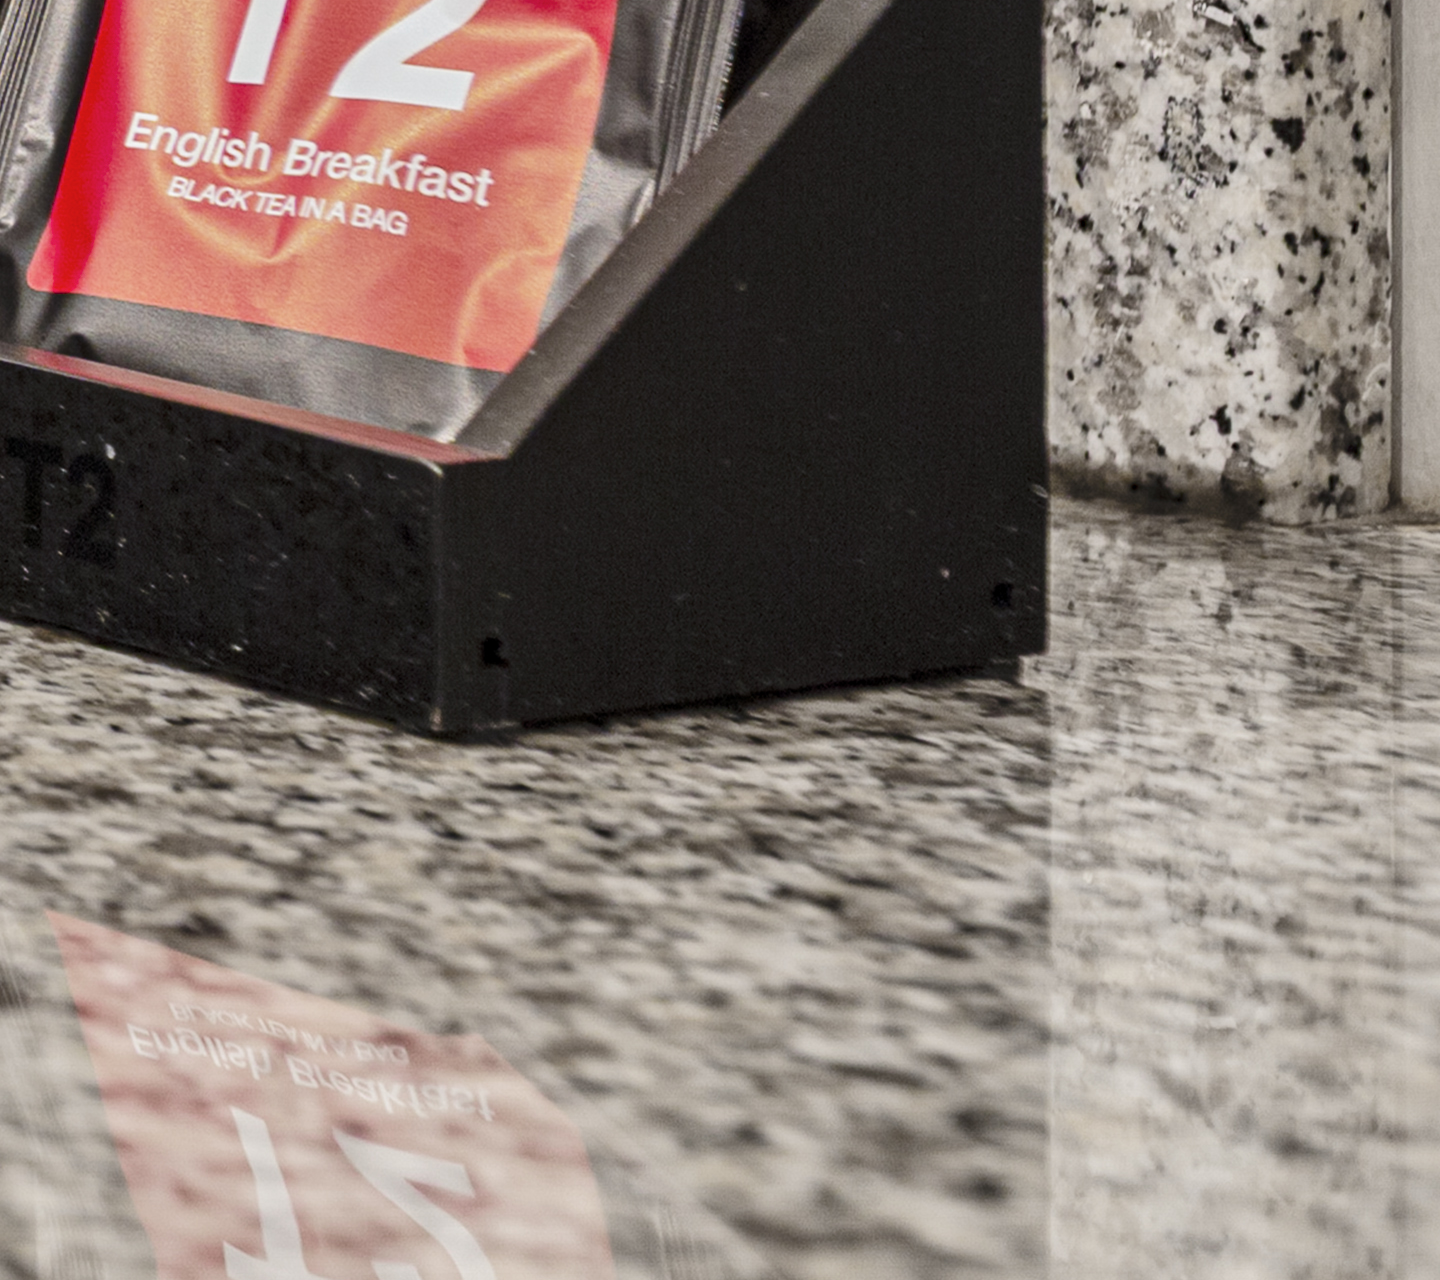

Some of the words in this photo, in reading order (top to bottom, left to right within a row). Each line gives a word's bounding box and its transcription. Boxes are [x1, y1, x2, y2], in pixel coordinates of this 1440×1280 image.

[124, 111, 272, 172] English
[283, 138, 495, 208] Breakfast
[166, 175, 253, 211] BLACK
[253, 191, 297, 217] TEA
[297, 196, 327, 220] IN
[325, 199, 347, 223] A
[350, 203, 410, 237] BAG
[5, 436, 118, 569] T2
